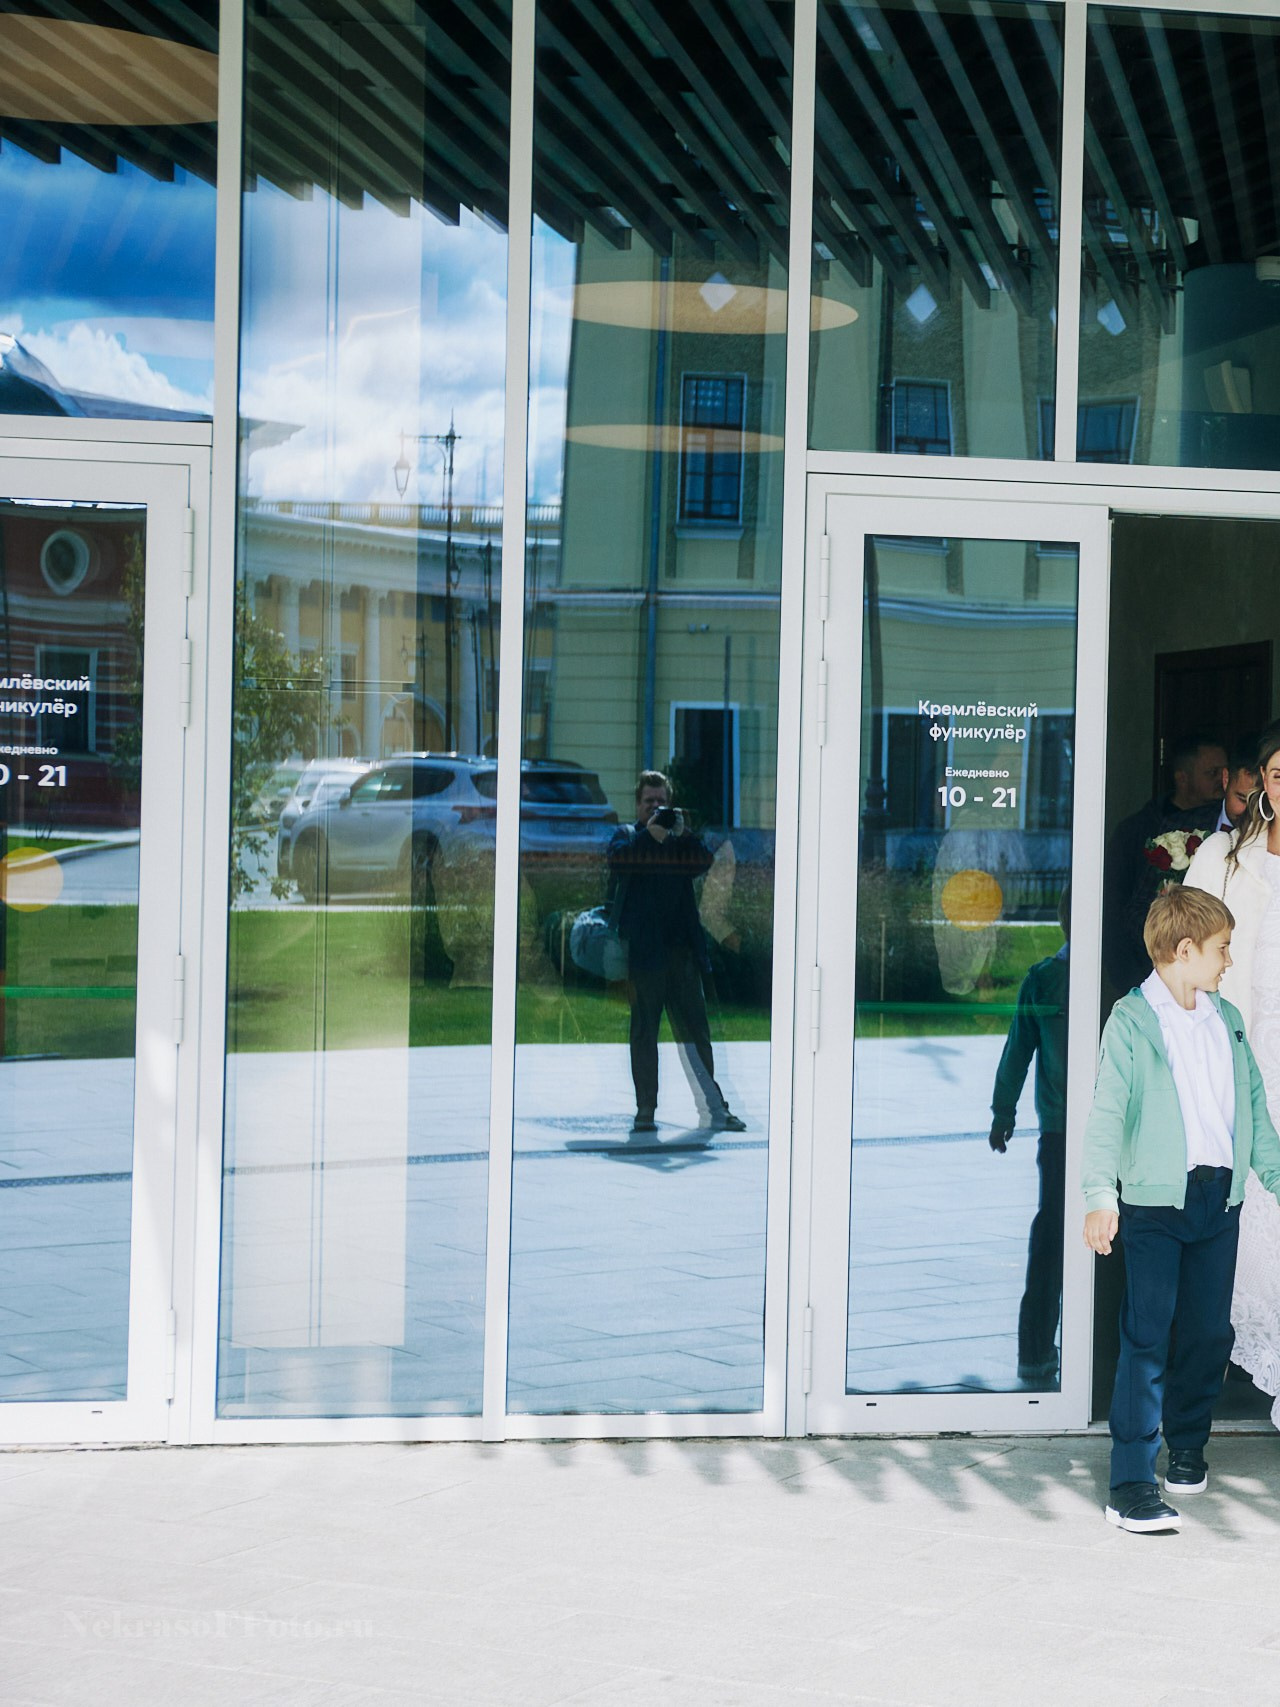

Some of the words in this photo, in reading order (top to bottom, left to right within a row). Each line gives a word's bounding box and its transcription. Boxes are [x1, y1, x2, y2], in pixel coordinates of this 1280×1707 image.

[0, 673, 90, 691] млёвский
[918, 700, 1038, 718] Кремлёвский
[929, 723, 1027, 743] фуникулёр
[0, 745, 59, 755] едневно
[38, 764, 67, 787] 21
[945, 767, 1010, 779] Ежедневно
[937, 786, 967, 808] 10
[991, 787, 1017, 808] 21
